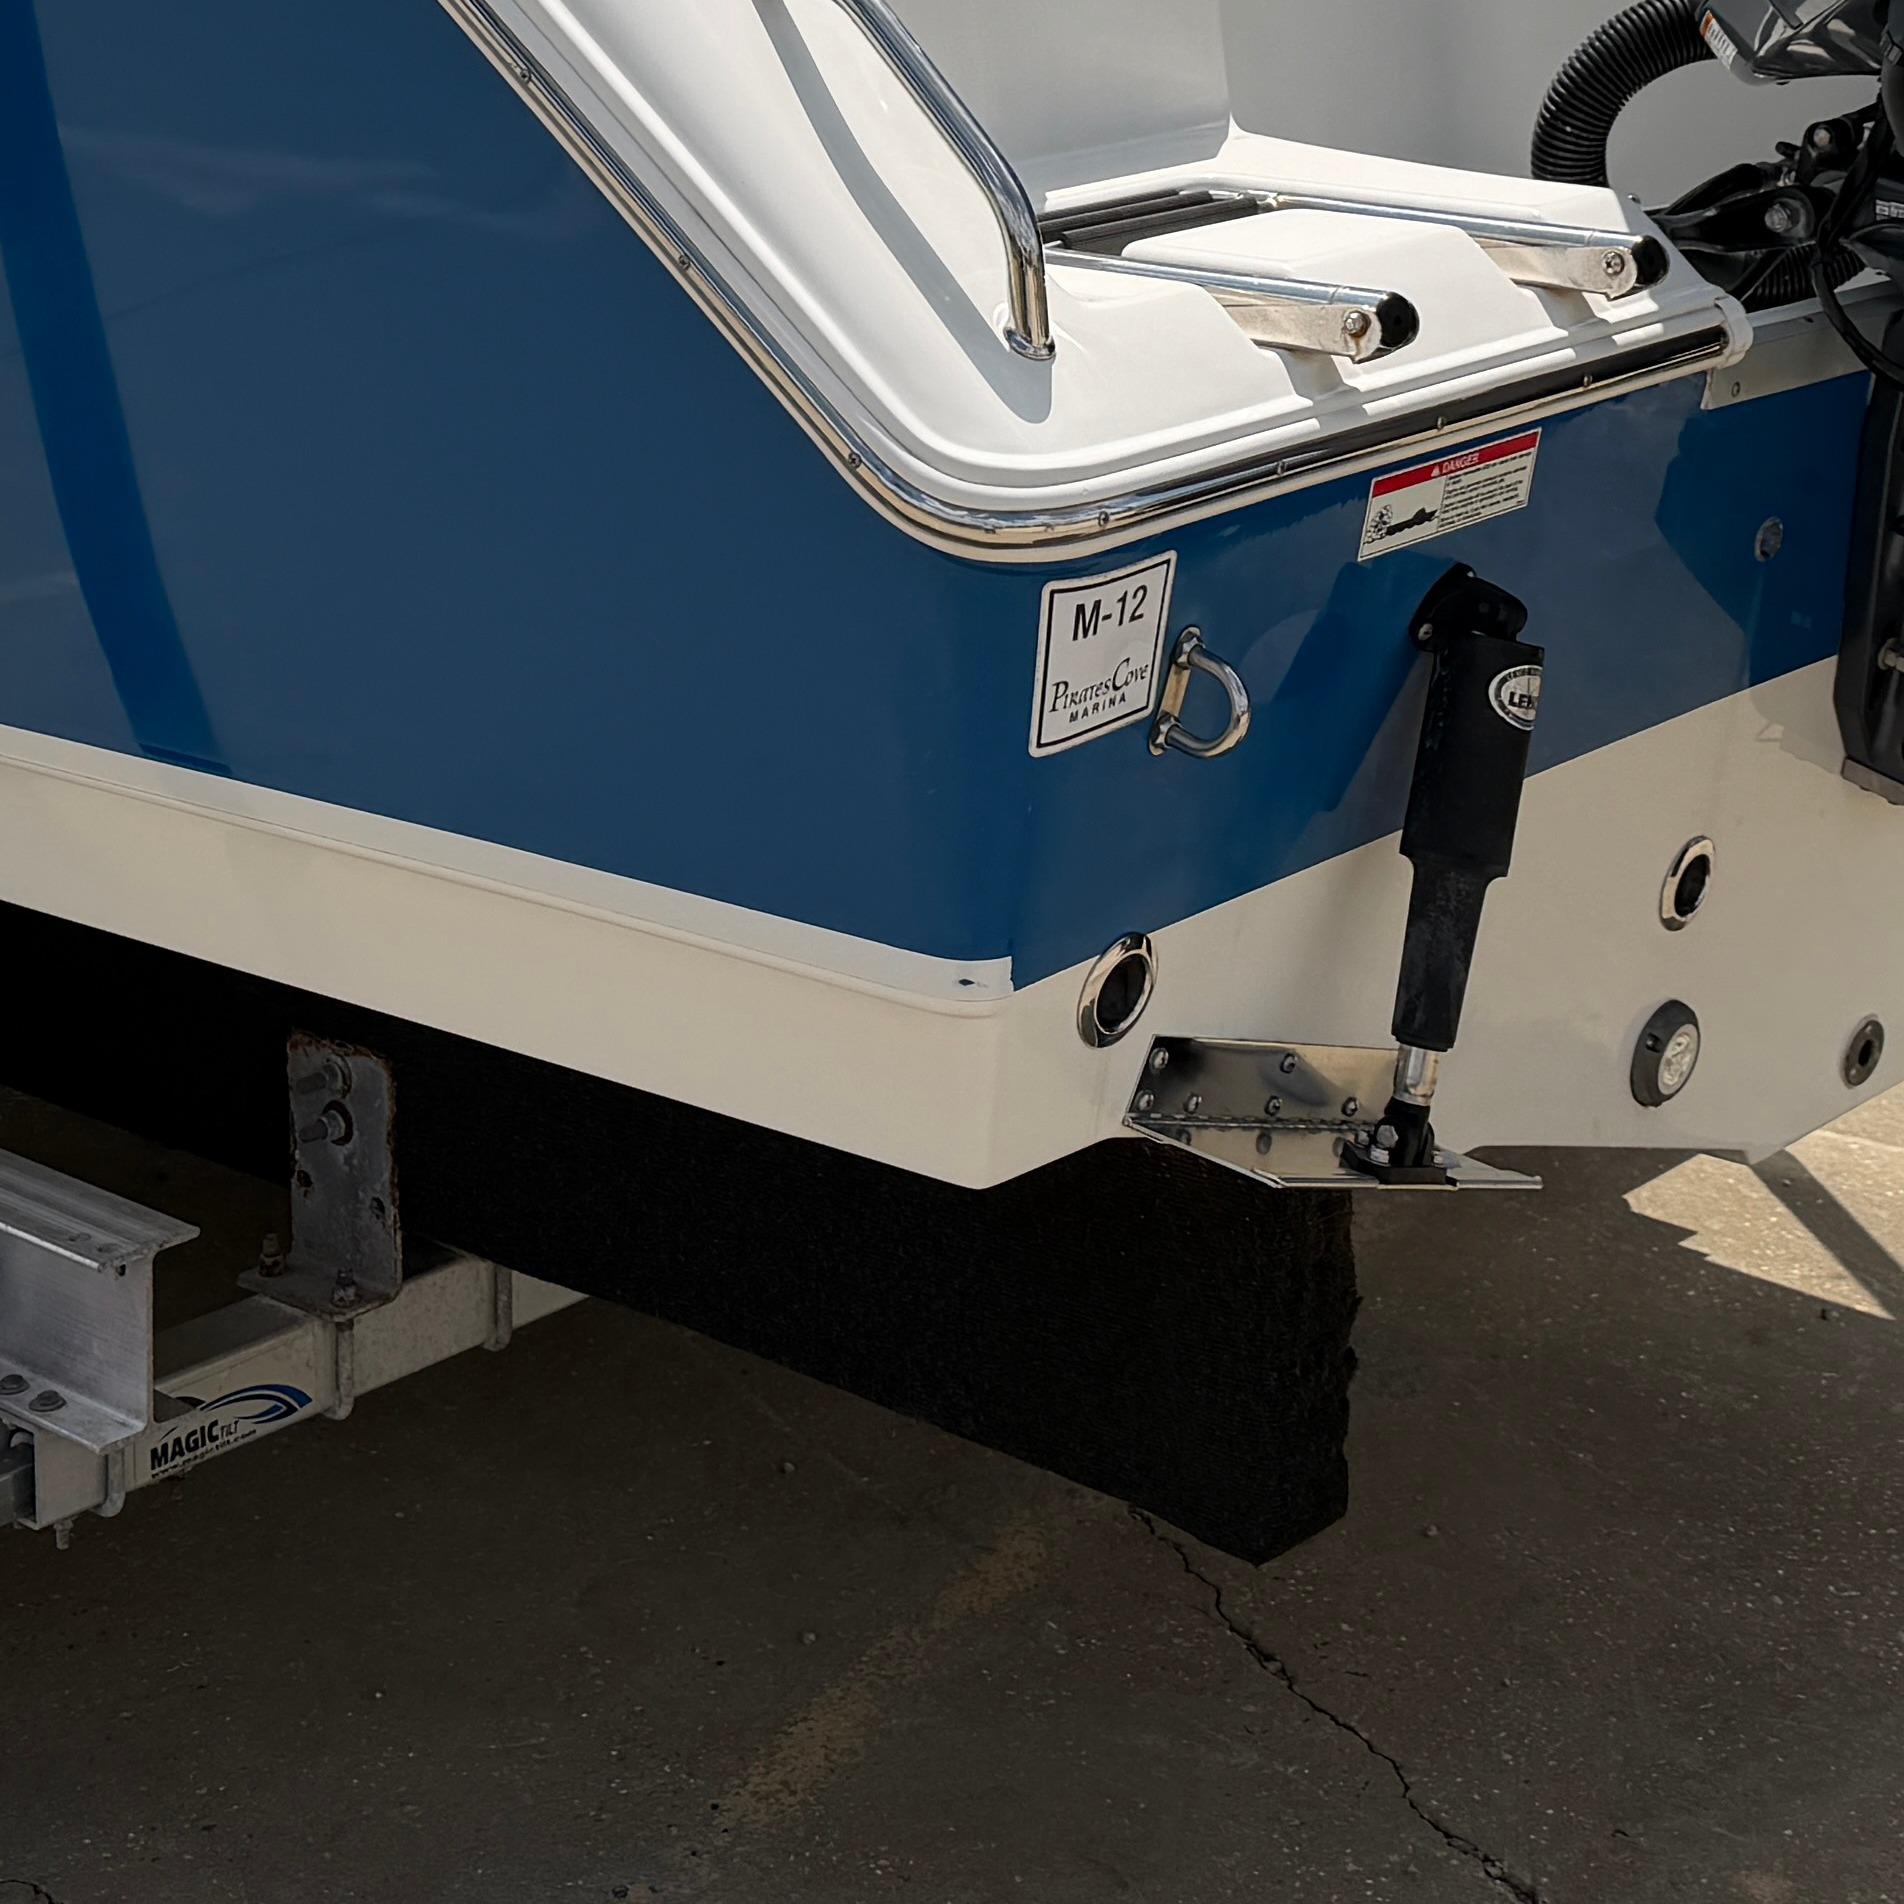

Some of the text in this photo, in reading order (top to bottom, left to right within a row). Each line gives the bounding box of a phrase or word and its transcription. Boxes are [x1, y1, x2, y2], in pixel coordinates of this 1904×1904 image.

[1441, 452, 1480, 475] DANGER
[1072, 584, 1148, 642] M-12
[1069, 692, 1126, 723] MARINA
[150, 1419, 219, 1471] MAGIC
